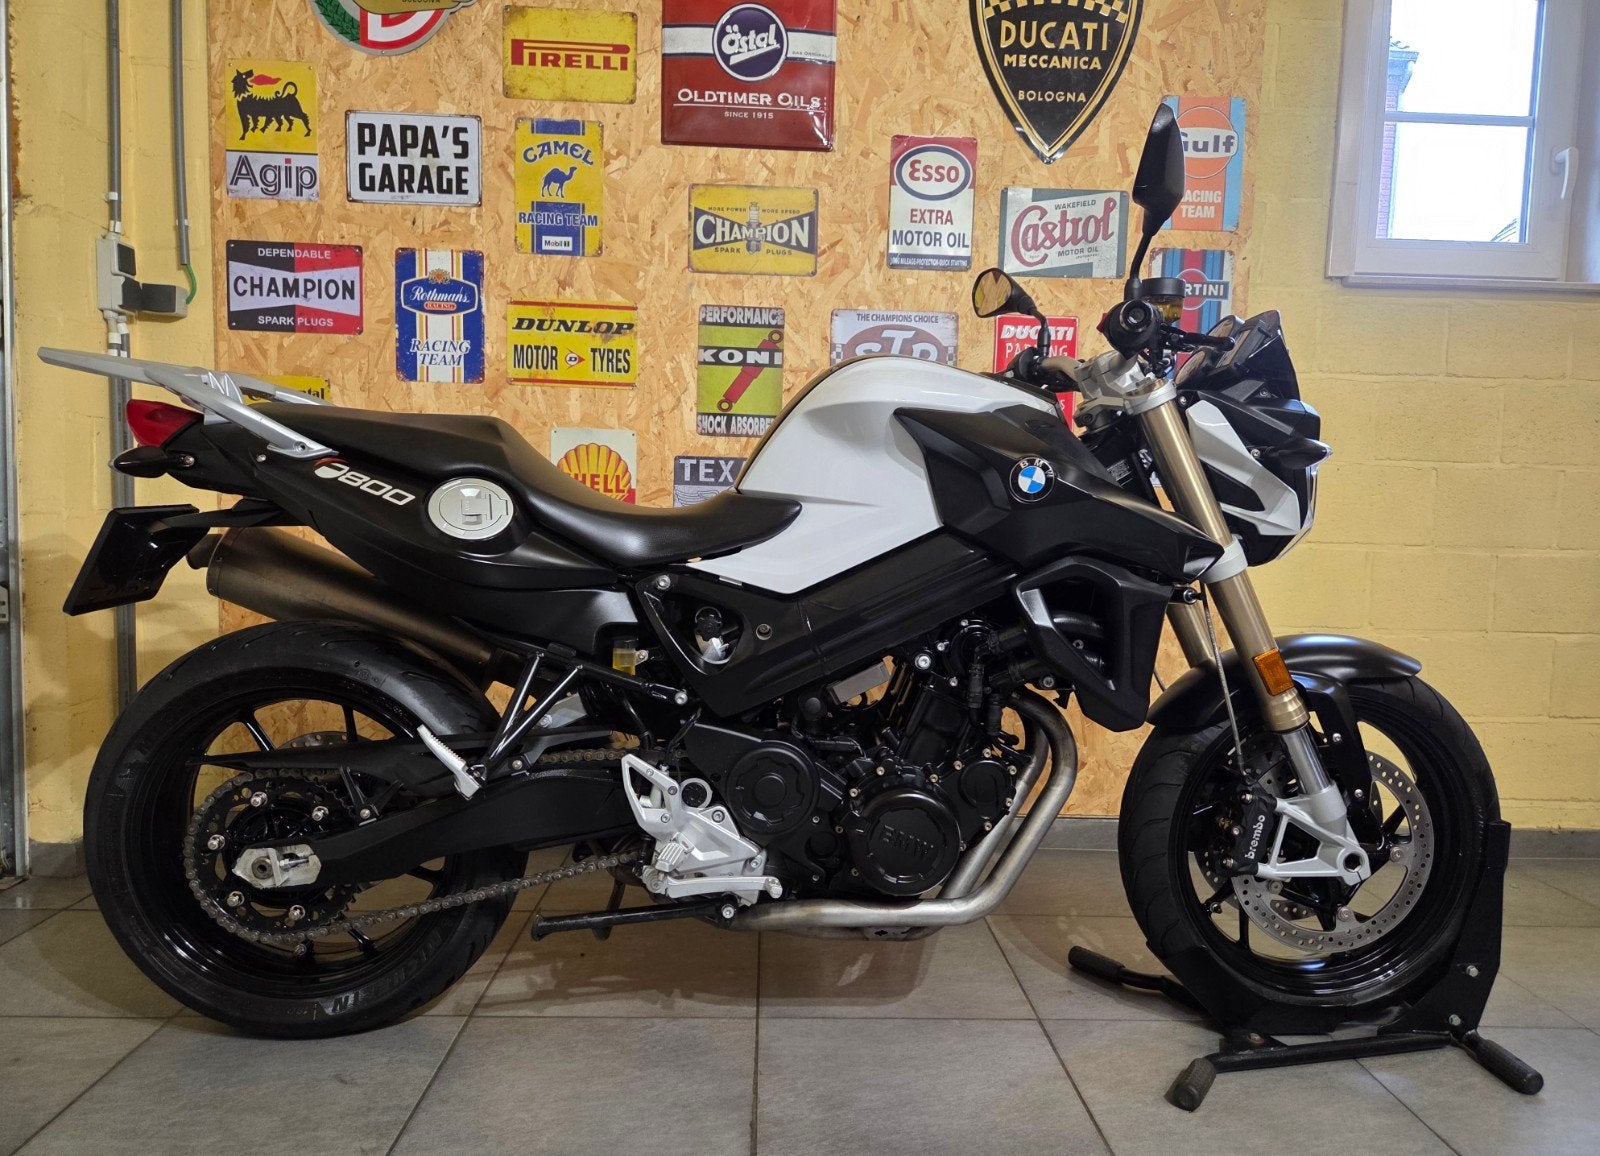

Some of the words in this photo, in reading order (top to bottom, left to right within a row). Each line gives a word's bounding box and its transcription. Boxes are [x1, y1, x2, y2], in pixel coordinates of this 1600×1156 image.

[721, 24, 779, 55] Östal
[1000, 20, 1109, 51] DUCATI
[511, 38, 631, 71] PIRELLI
[1003, 53, 1102, 70] MECCANICA
[677, 88, 772, 106] OLDTIMER
[777, 92, 821, 108] OILS
[1018, 89, 1087, 102] BOLOGNA
[724, 111, 749, 119] SINCE
[357, 122, 469, 159] PAPA'S
[523, 140, 594, 166] CAMEL
[229, 154, 317, 197] Agip
[359, 162, 469, 195] GARAGE
[908, 158, 960, 184] Esso
[1054, 199, 1097, 211] WAKEFIELD
[1182, 190, 1222, 203] ACING
[518, 211, 563, 226] RACING
[566, 213, 598, 227] TEAM
[910, 208, 954, 225] EXTRA
[1181, 205, 1215, 218] TEAM
[696, 214, 810, 248] CHAMPION
[892, 229, 942, 247] MOTOR
[946, 231, 970, 249] OIL
[1011, 197, 1117, 267] Castrol
[544, 239, 563, 247] Mobil
[766, 248, 792, 256] PLUGS
[257, 248, 331, 259] DEPENDABLE
[1057, 248, 1085, 257] MOTOR
[233, 275, 355, 300] CHAMPION
[1184, 282, 1224, 296] RTINI
[258, 316, 295, 326] SPARK
[297, 317, 334, 327] PLUGS
[699, 306, 785, 325] PERFORMANCE
[857, 313, 870, 322] THE
[871, 313, 913, 323] CHAMPIONS
[914, 315, 939, 323] CHOICE
[512, 317, 635, 335] DUNLOP
[410, 338, 471, 354] RACING
[420, 354, 463, 366] TEAM
[513, 344, 558, 370] MOTOR
[590, 347, 631, 374] TYRES
[698, 348, 783, 365] KONI
[697, 414, 727, 434] SHOCK
[569, 473, 626, 494] HELL
[1244, 814, 1266, 860] brembo
